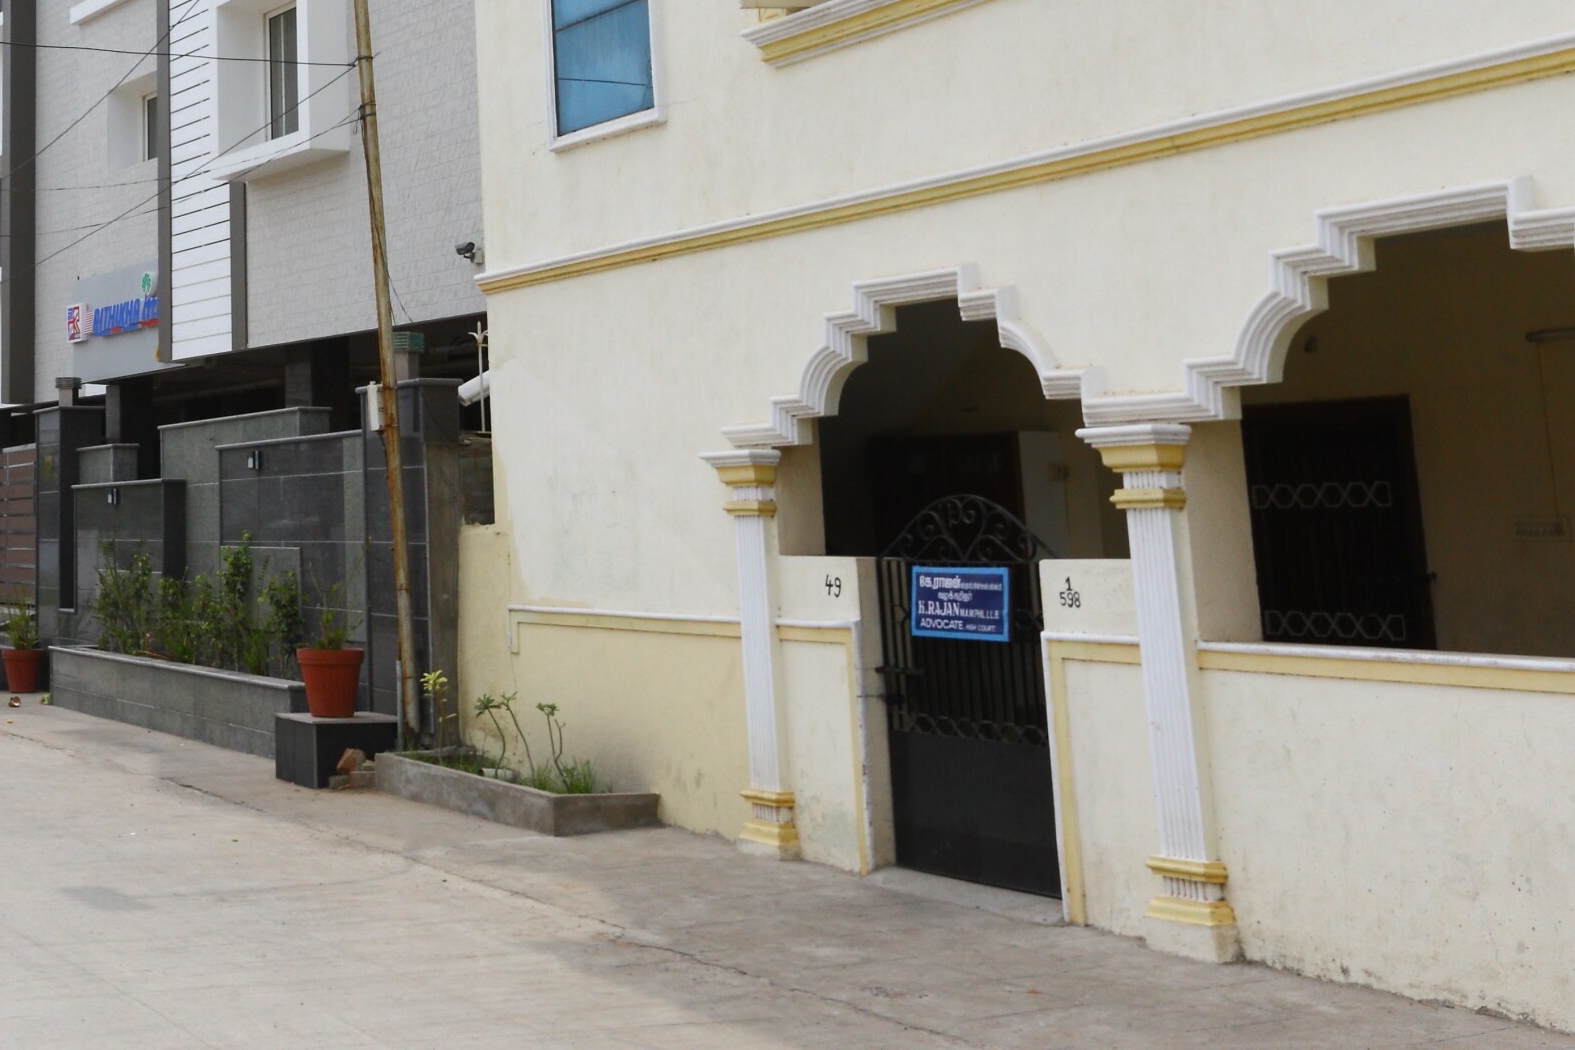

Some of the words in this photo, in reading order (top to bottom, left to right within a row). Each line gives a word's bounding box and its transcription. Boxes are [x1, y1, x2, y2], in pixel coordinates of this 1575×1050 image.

[825, 574, 842, 598] 49
[1065, 576, 1073, 591] 1
[1059, 591, 1081, 608] 598
[918, 600, 960, 616] K.RAJAN
